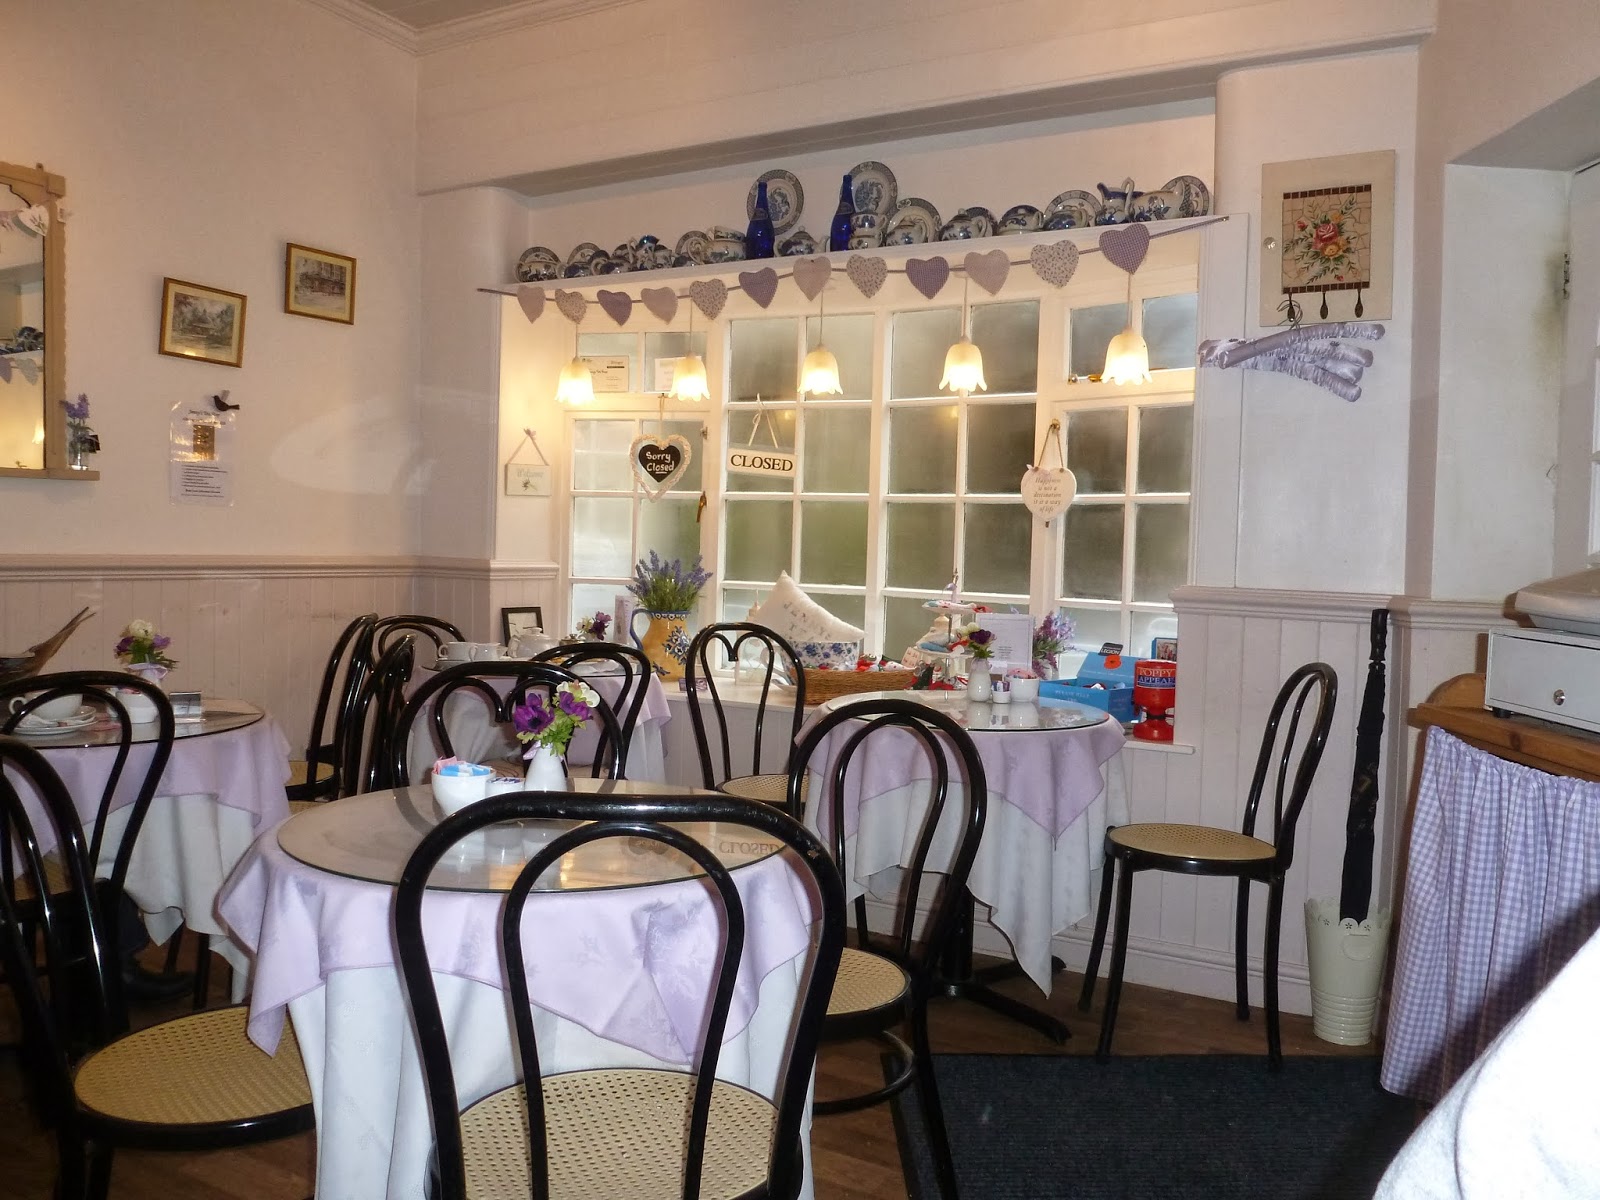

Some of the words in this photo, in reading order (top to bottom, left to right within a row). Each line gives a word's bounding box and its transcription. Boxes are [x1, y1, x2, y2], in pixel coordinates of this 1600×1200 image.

[645, 451, 671, 462] Sorry
[646, 461, 675, 472] Closed
[730, 453, 793, 472] CLOSED
[1139, 668, 1173, 677] POPPY
[1139, 676, 1174, 685] APPEAL
